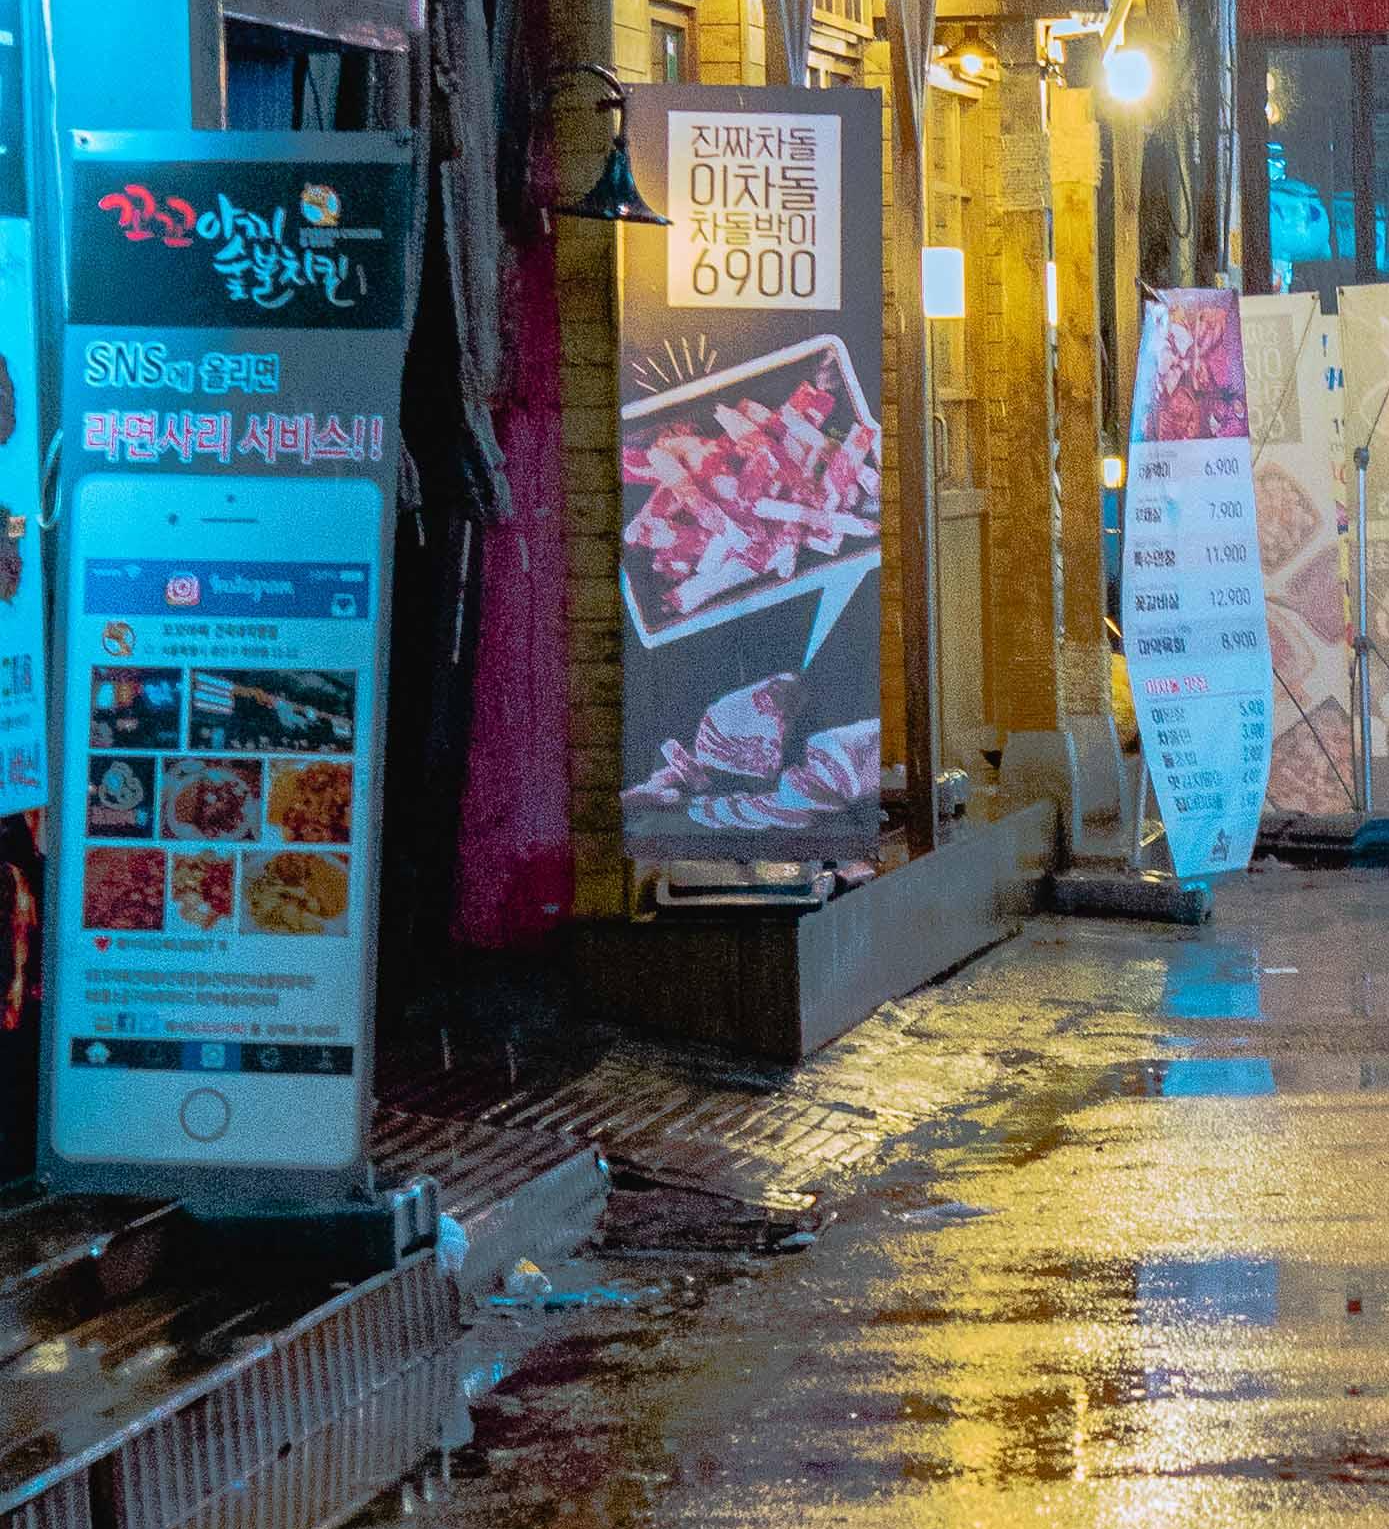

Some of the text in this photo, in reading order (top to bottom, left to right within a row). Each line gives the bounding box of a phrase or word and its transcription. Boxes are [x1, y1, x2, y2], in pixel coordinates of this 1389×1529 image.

[691, 125, 817, 161] 진짜차돌
[691, 163, 818, 211] 이차돌
[690, 211, 815, 245] 차돌박이
[693, 248, 816, 298] 6900
[84, 410, 384, 463] 라면사리 서비스!!
